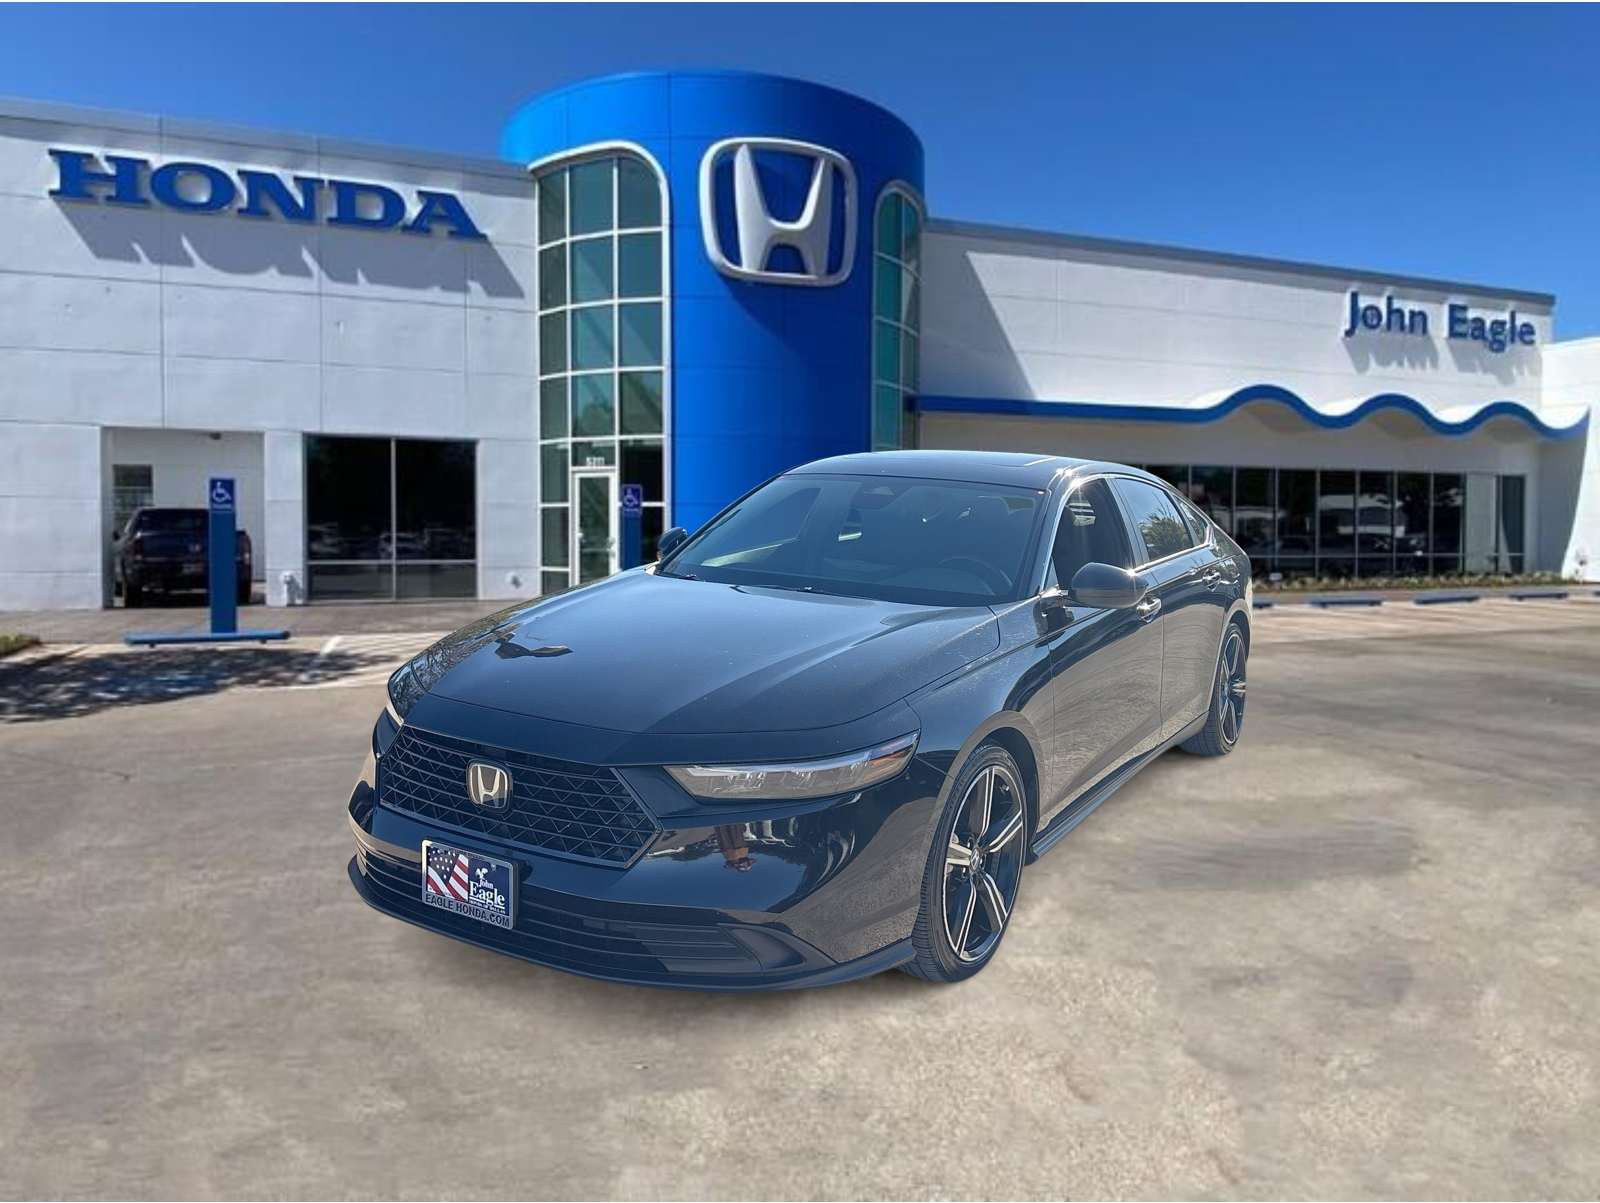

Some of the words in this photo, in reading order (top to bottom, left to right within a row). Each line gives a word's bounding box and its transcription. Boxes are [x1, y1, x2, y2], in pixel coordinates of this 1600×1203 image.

[48, 148, 489, 241] HONDA
[1344, 290, 1428, 338] John
[1448, 303, 1536, 353] Eagle
[469, 880, 506, 907] Eagle
[478, 879, 494, 890] John
[426, 893, 454, 910] EAGLE
